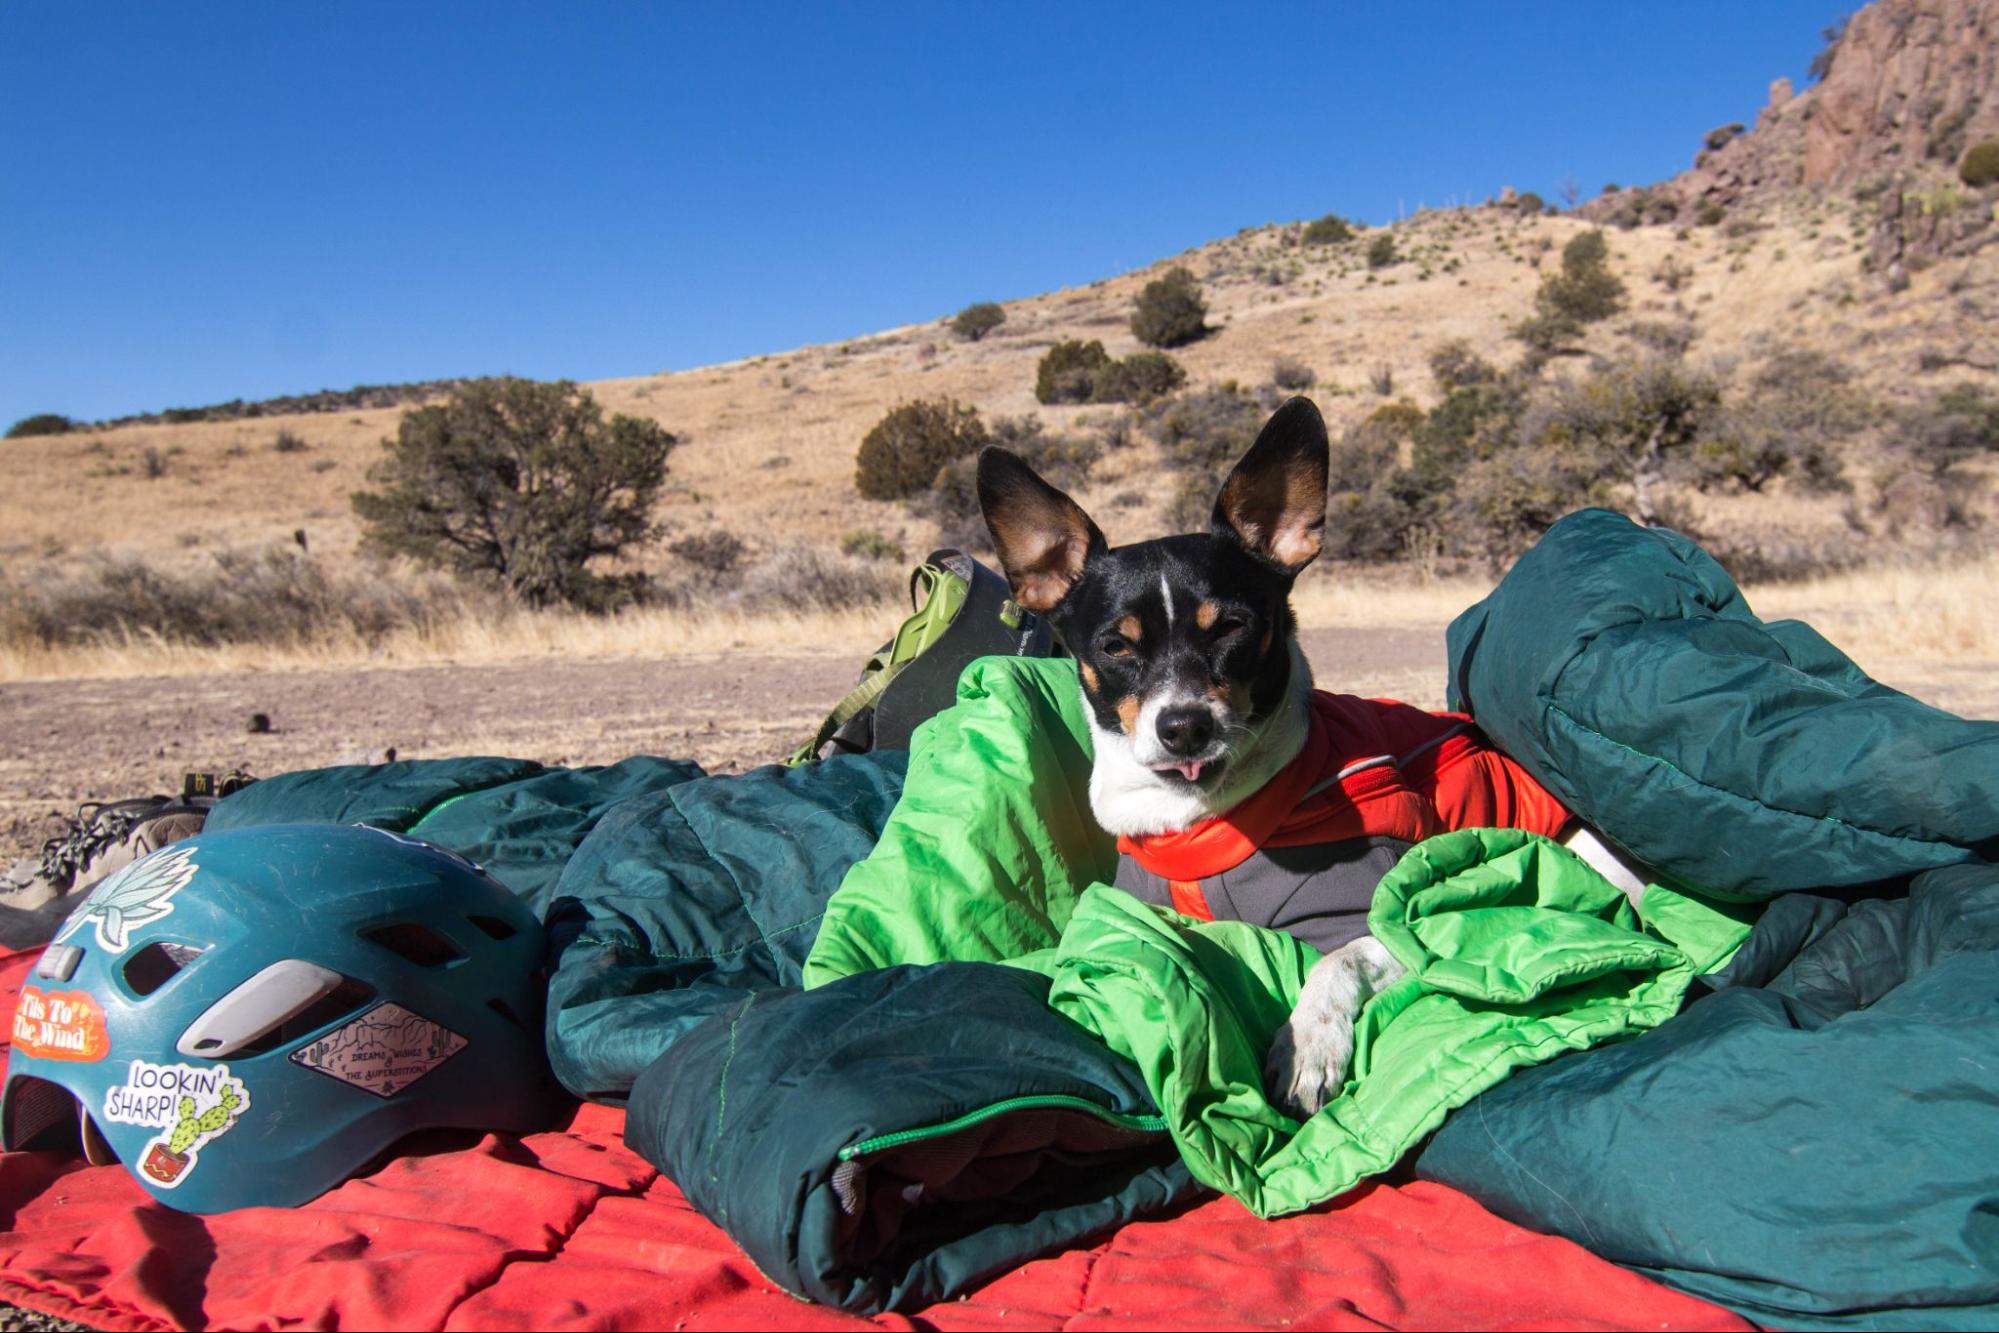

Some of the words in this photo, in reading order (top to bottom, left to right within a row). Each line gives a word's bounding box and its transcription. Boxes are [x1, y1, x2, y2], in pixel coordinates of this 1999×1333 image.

[49, 999, 73, 1024] To
[14, 1014, 36, 1041] The
[40, 1021, 85, 1050] Wind
[352, 1052, 386, 1061] DREAMS
[133, 1066, 222, 1094] LOOKIN'
[346, 1071, 362, 1080] THE
[109, 1092, 177, 1123] SHARP!
